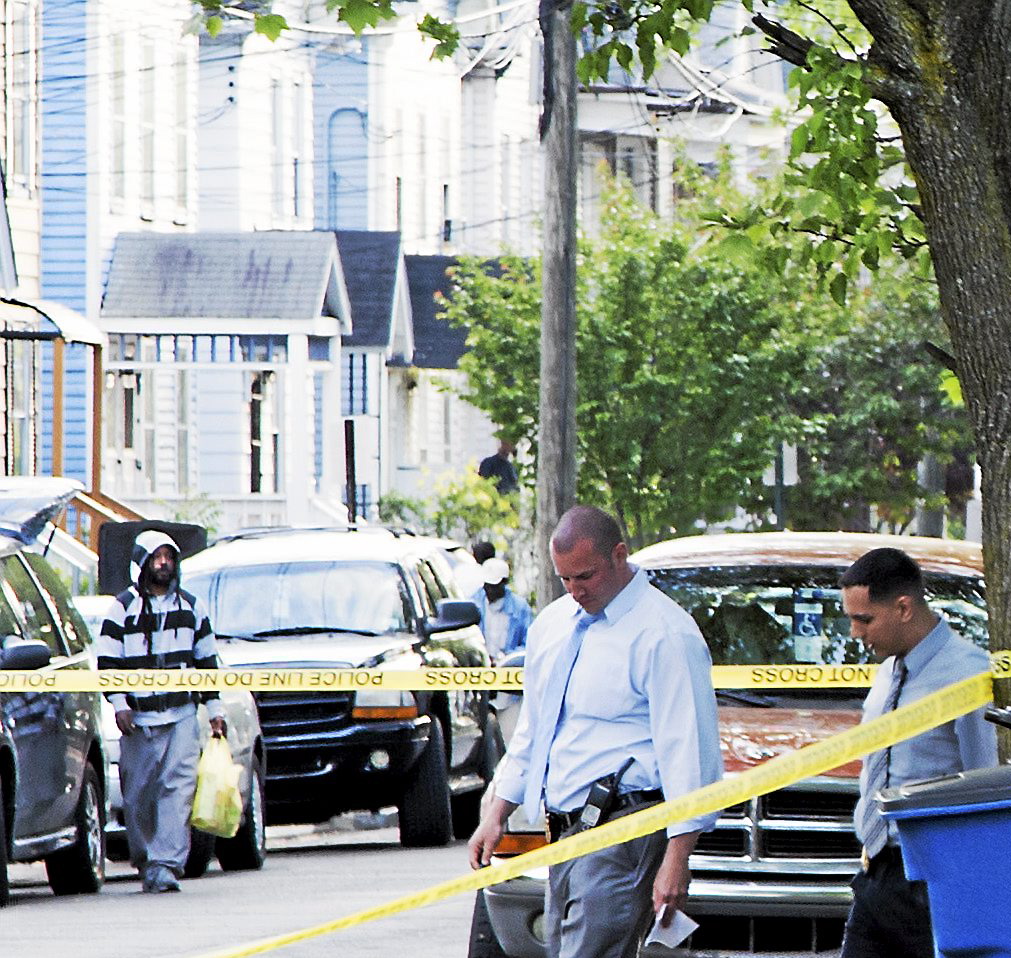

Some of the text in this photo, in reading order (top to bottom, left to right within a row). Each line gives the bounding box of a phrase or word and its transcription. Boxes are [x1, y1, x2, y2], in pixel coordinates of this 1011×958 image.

[98, 672, 171, 687] CROSS
[176, 671, 218, 687] NOT
[224, 671, 255, 686] DO
[260, 671, 303, 686] LINE
[310, 671, 384, 686] POLICE
[426, 670, 497, 685] CROSS
[502, 670, 524, 685] OT
[751, 667, 871, 683] NOT CROSS
